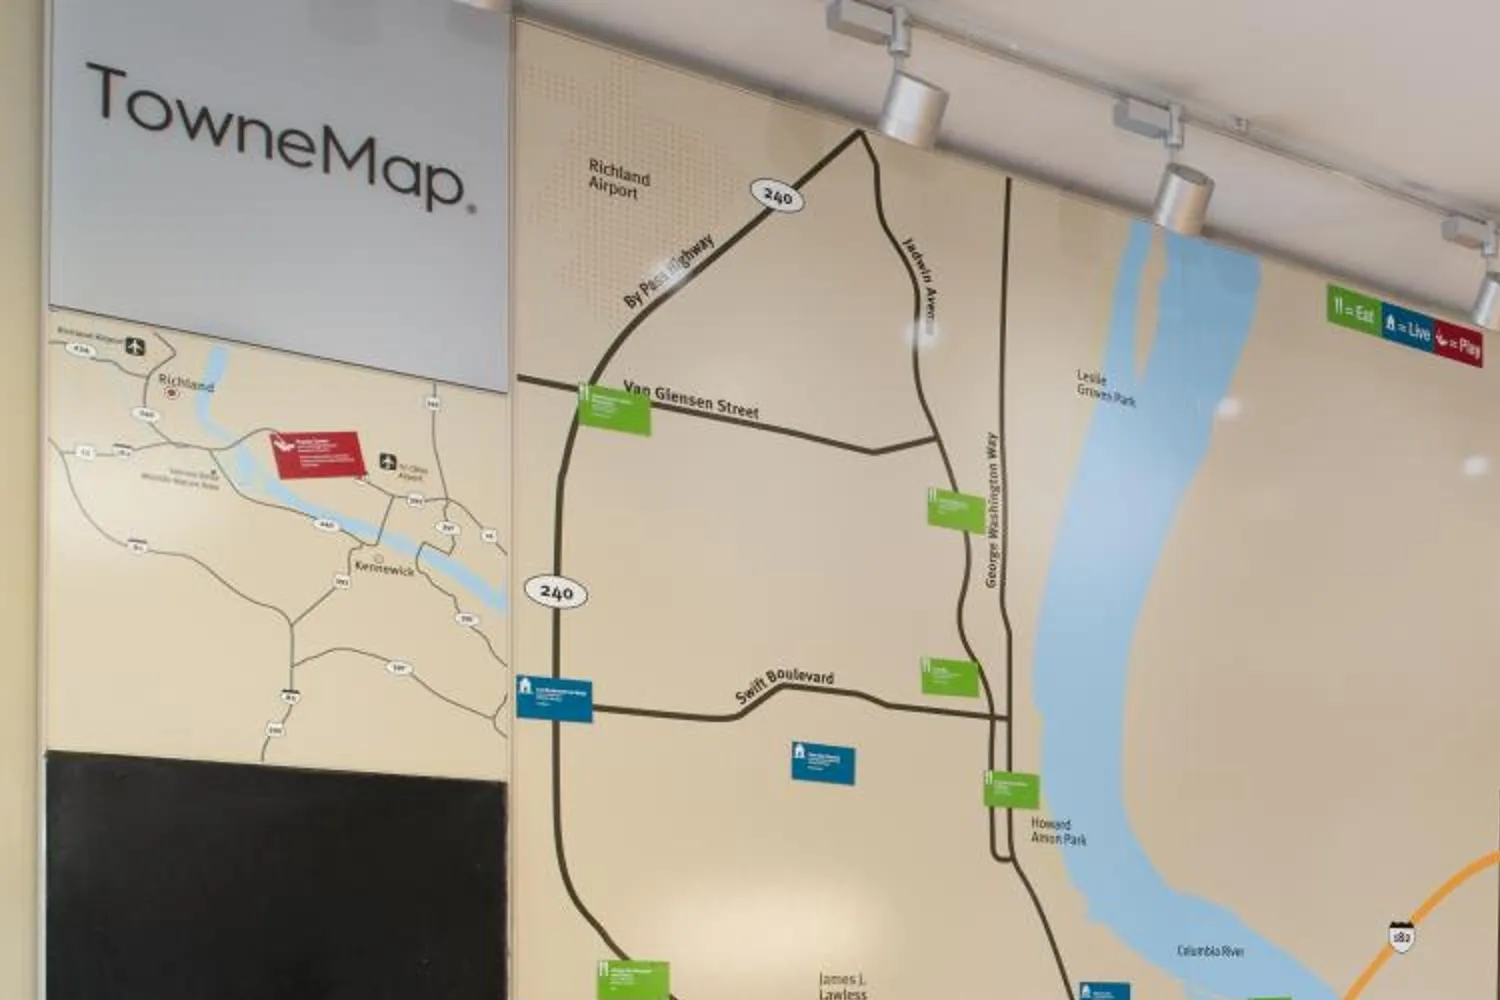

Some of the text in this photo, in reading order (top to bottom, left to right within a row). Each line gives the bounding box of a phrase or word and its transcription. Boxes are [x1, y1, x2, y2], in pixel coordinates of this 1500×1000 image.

[86, 62, 465, 213] TowneMap
[588, 158, 651, 187] Richland
[588, 175, 638, 201] Airport
[763, 186, 793, 205] 240
[623, 289, 644, 310] By
[668, 232, 716, 272] Highway
[902, 237, 932, 284] Jadwin
[1355, 304, 1375, 324] Eat
[1408, 320, 1431, 342] Live
[1459, 337, 1481, 360] Play
[158, 373, 216, 393] Richland
[623, 378, 651, 397] Van
[717, 399, 760, 420] Street
[985, 431, 1000, 589] George Washington Way
[355, 560, 416, 578] Kennewick
[540, 585, 574, 601] 240
[735, 667, 835, 705] Swift Boulevard
[819, 972, 856, 986] James
[819, 988, 869, 1000] Lawless
